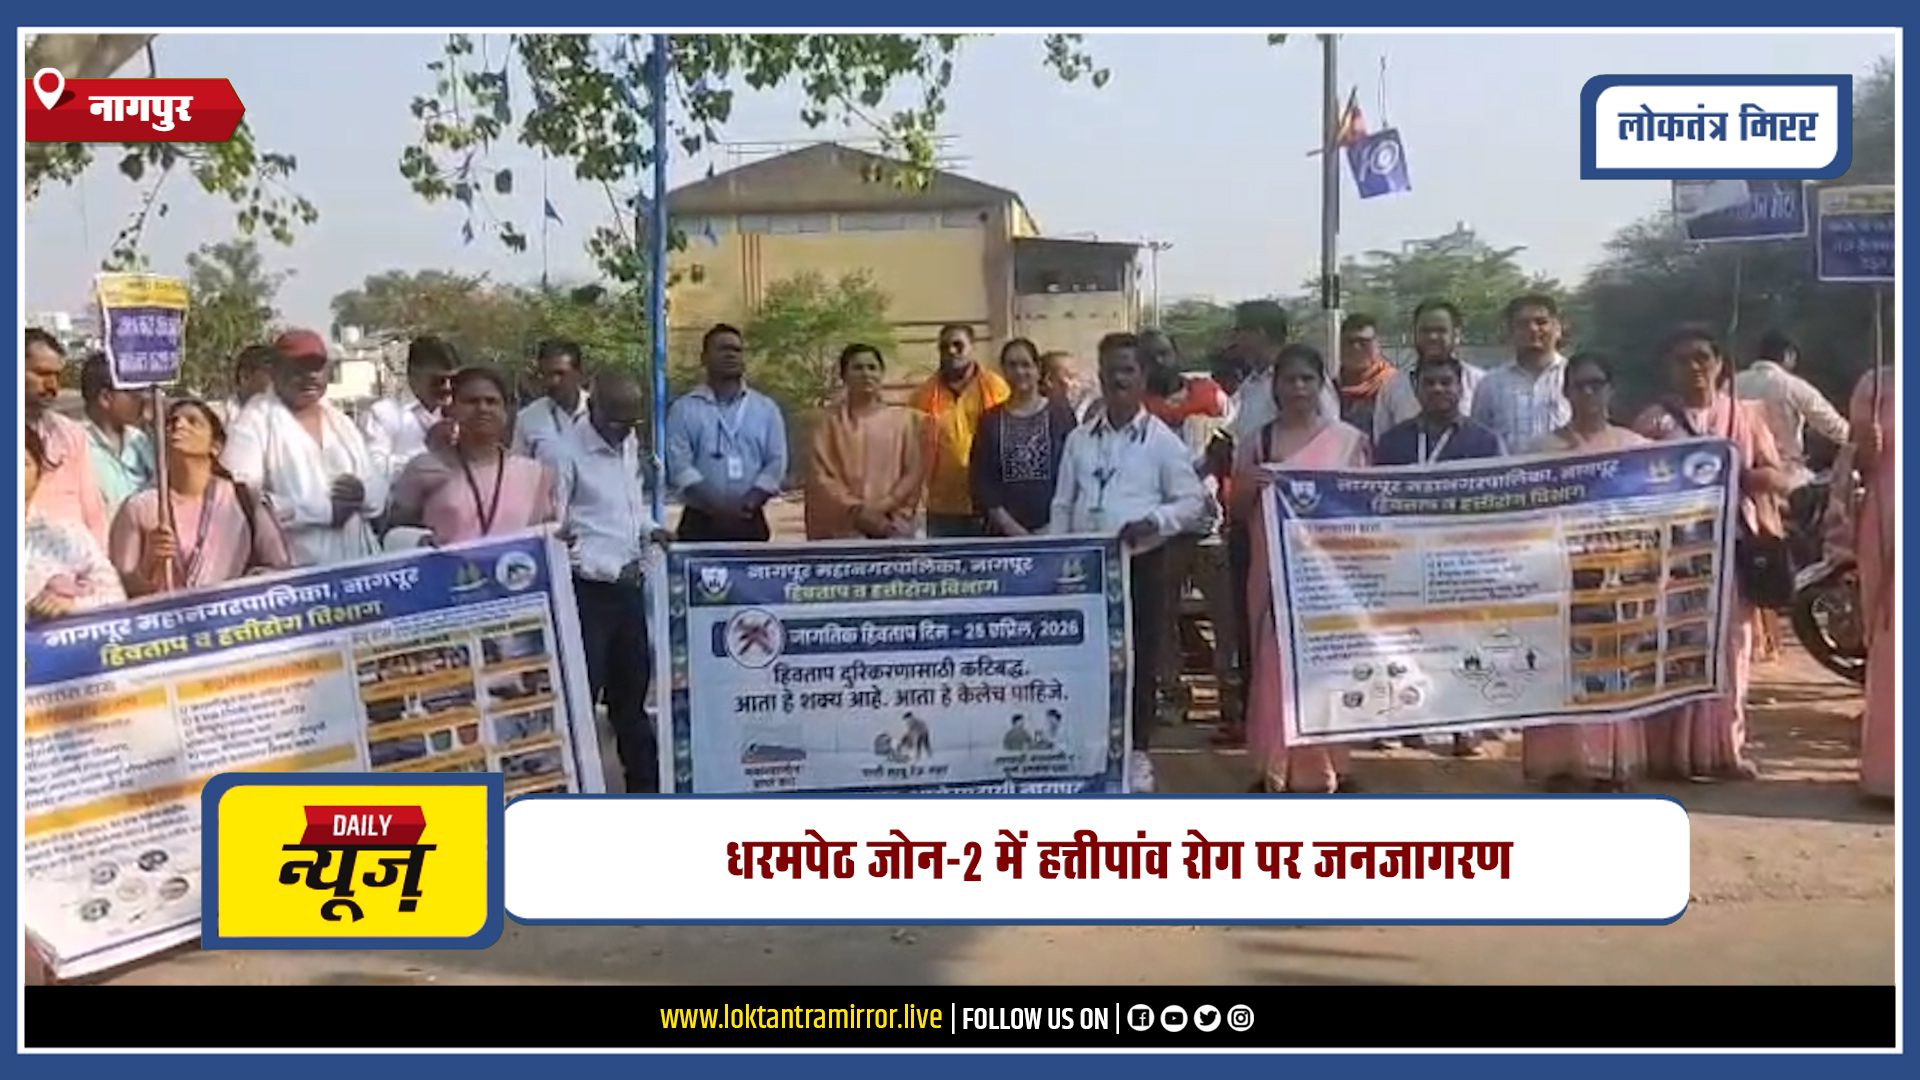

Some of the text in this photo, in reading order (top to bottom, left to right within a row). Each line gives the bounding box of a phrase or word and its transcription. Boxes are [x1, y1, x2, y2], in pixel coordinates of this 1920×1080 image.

[192, 632, 213, 649] व
[788, 622, 857, 646] जागतिक
[918, 618, 950, 642] दिन
[1040, 619, 1079, 638] 2026
[773, 660, 835, 686] हिवताप
[734, 677, 1069, 714] आता हे शक्य आहे. आता हे केलेच पाहिजे.
